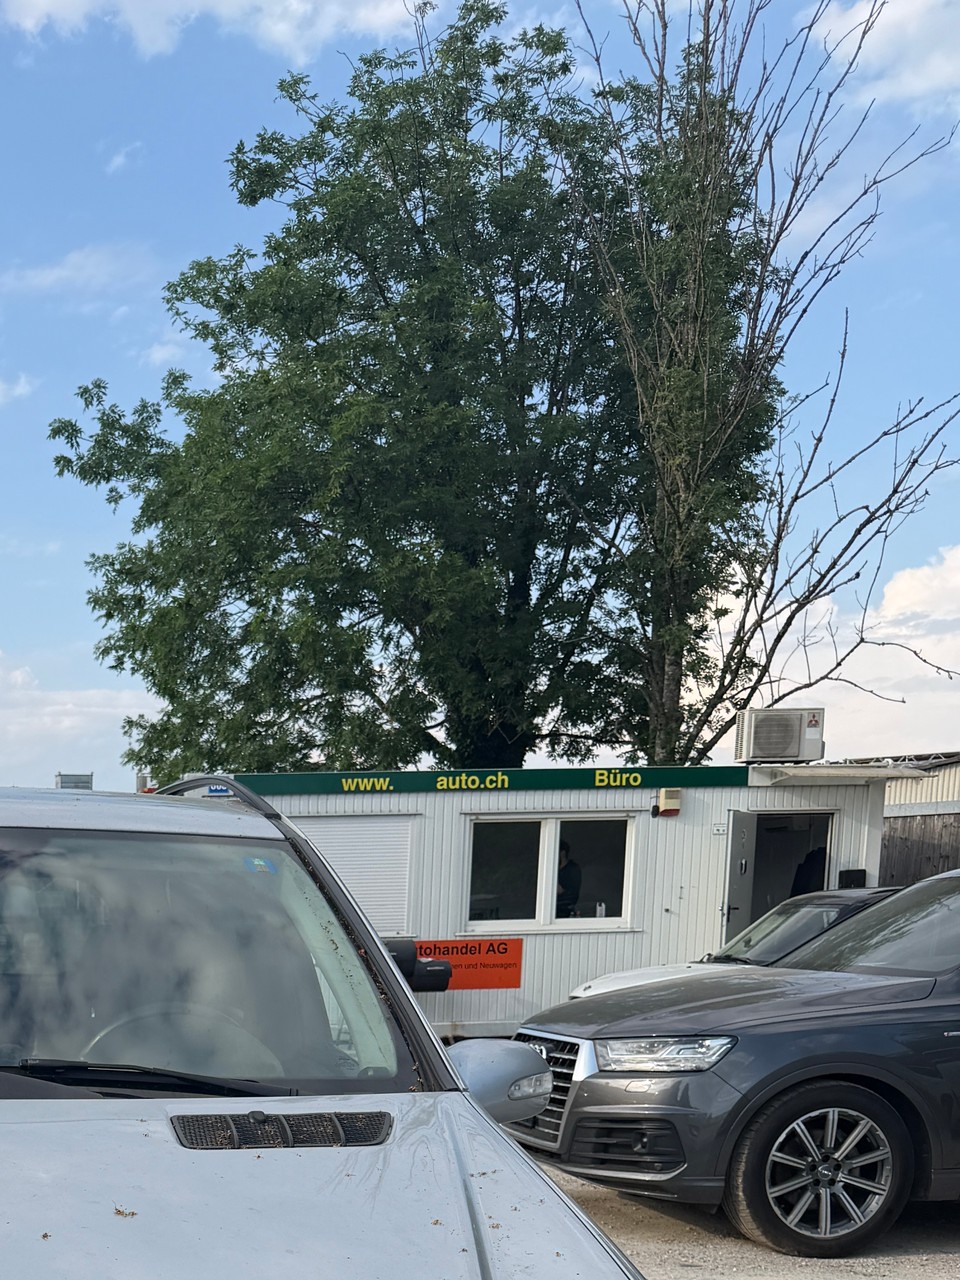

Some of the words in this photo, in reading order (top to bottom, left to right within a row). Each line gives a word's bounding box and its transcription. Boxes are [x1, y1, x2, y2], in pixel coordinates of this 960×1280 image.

[341, 778, 394, 791] www.
[436, 772, 509, 790] auto.ch
[594, 769, 642, 787] Büro
[416, 943, 482, 956] tohandel
[485, 942, 508, 955] AG
[479, 962, 518, 971] Neuwagen
